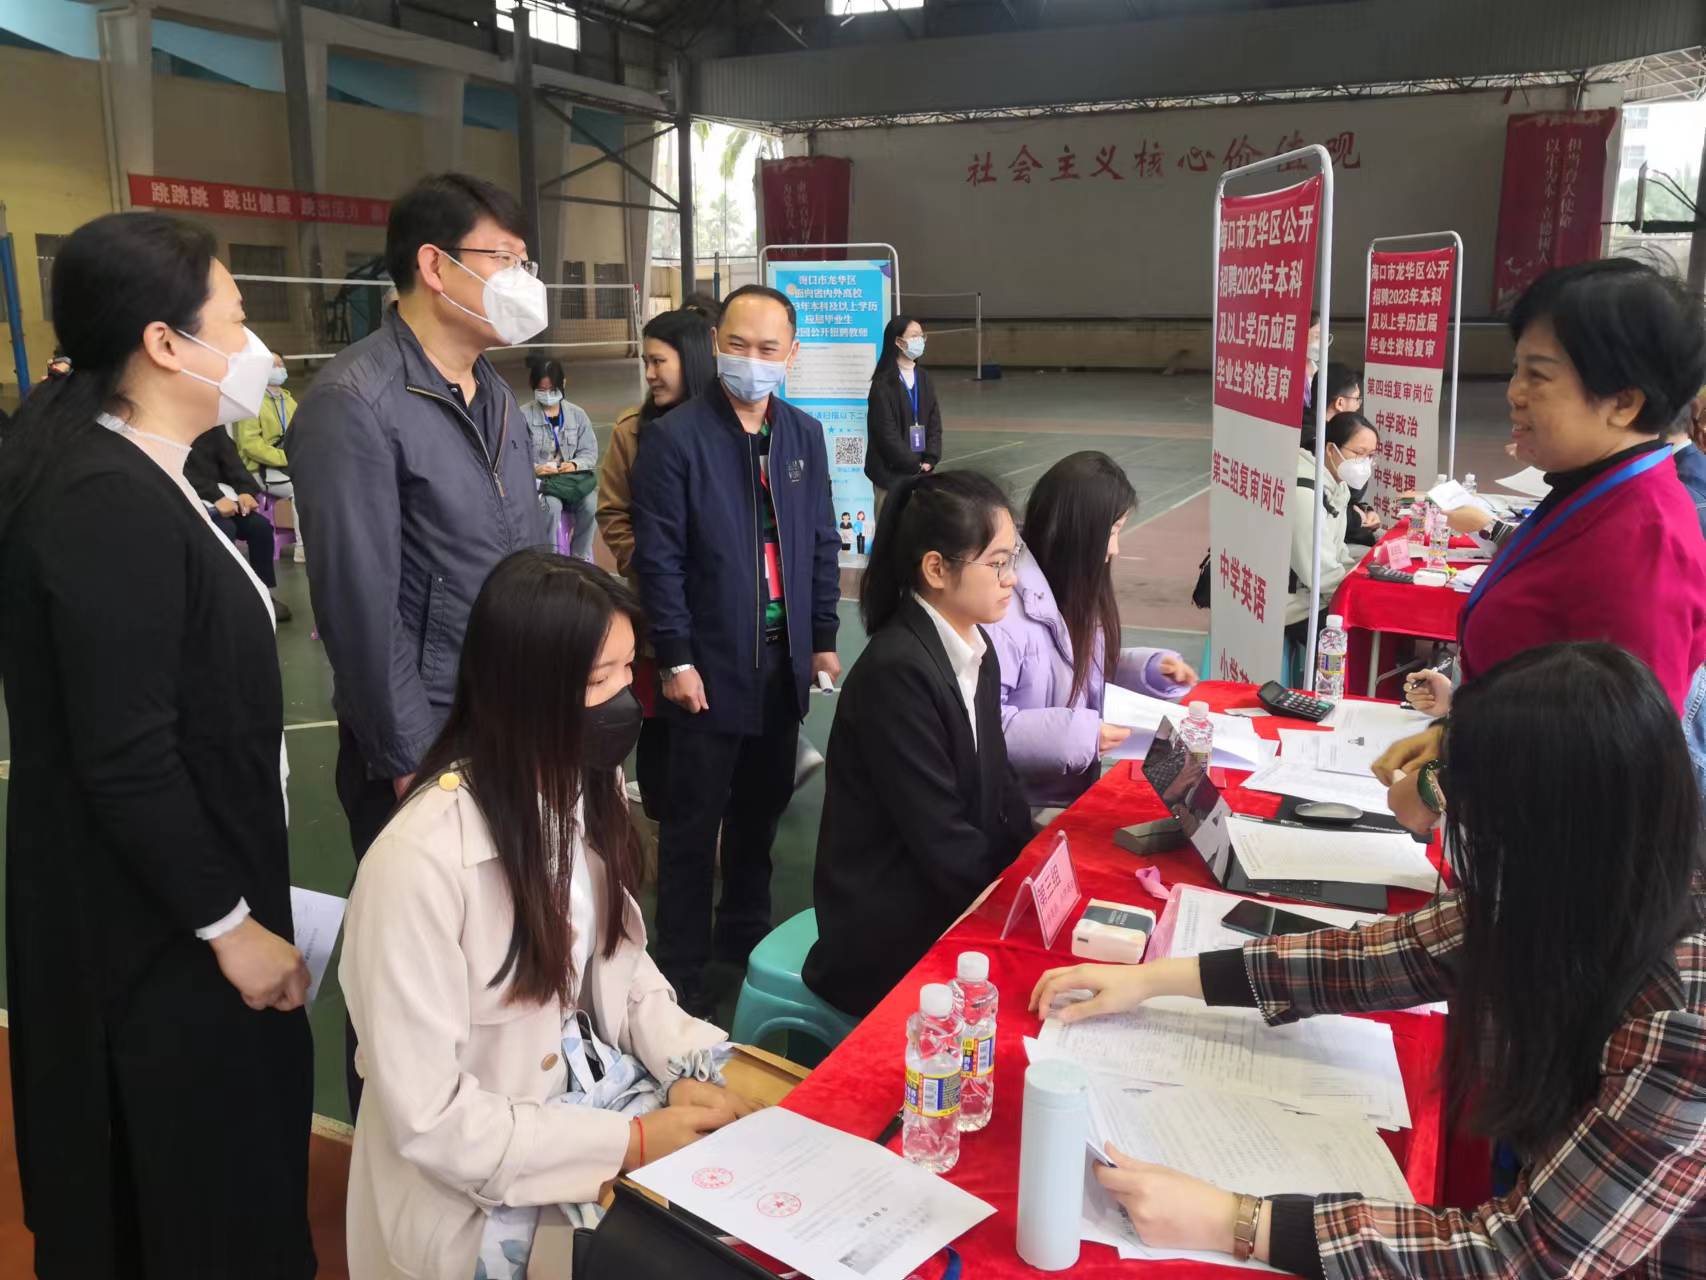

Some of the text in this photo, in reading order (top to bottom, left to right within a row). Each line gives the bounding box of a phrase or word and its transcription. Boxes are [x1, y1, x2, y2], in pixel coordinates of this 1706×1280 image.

[967, 131, 1361, 188] 社会主义核心价值观
[151, 181, 210, 208] 跳跳跳
[223, 189, 294, 215] 跳出健康
[1219, 204, 1315, 252] 海口市龙华区公开
[799, 275, 857, 286] 海口市龙华区
[1219, 257, 1304, 299] 招聘2023年本科
[1371, 259, 1450, 282] 海口市龙华区公开
[793, 301, 878, 312] 3年本科及以上学历
[1372, 286, 1443, 307] 招聘2023年本科
[1217, 311, 1297, 352] 及以上学历应届
[1371, 312, 1438, 333] 及以上学历应届
[1370, 337, 1436, 359] 毕业生资格复审
[1215, 355, 1293, 405] 毕业生资格复审
[1367, 377, 1434, 404] 第四组复审岗位
[1375, 409, 1419, 438] 中学政治
[1376, 440, 1417, 467] 中学历史
[1211, 448, 1287, 517] 第三组复审岗位
[1374, 465, 1416, 493] 中学地理
[1219, 547, 1267, 624] 中学英语
